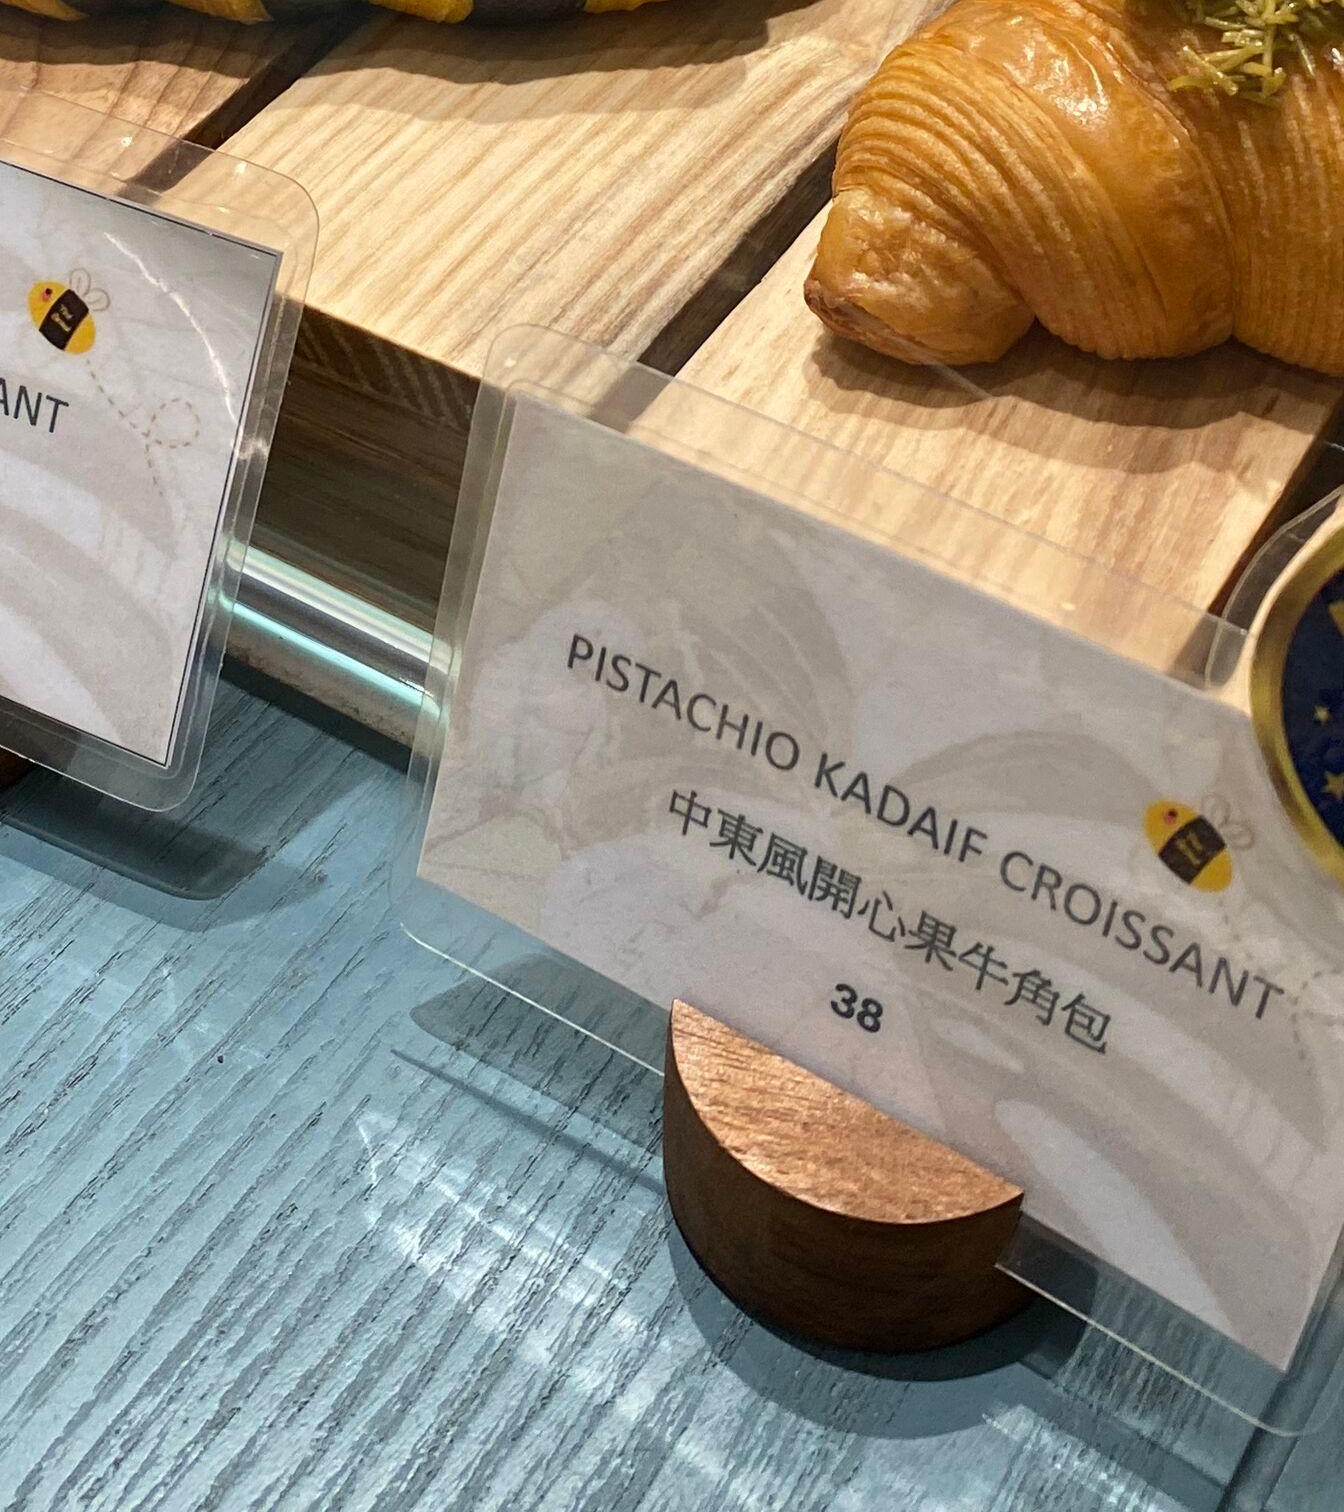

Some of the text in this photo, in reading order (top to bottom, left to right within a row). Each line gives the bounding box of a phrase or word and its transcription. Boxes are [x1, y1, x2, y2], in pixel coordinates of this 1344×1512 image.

[566, 632, 1286, 1022] PISTACHIO KADAIF CROISSANT
[668, 788, 1114, 1057] 中東風開心果牛角包
[829, 982, 885, 1036] 38
